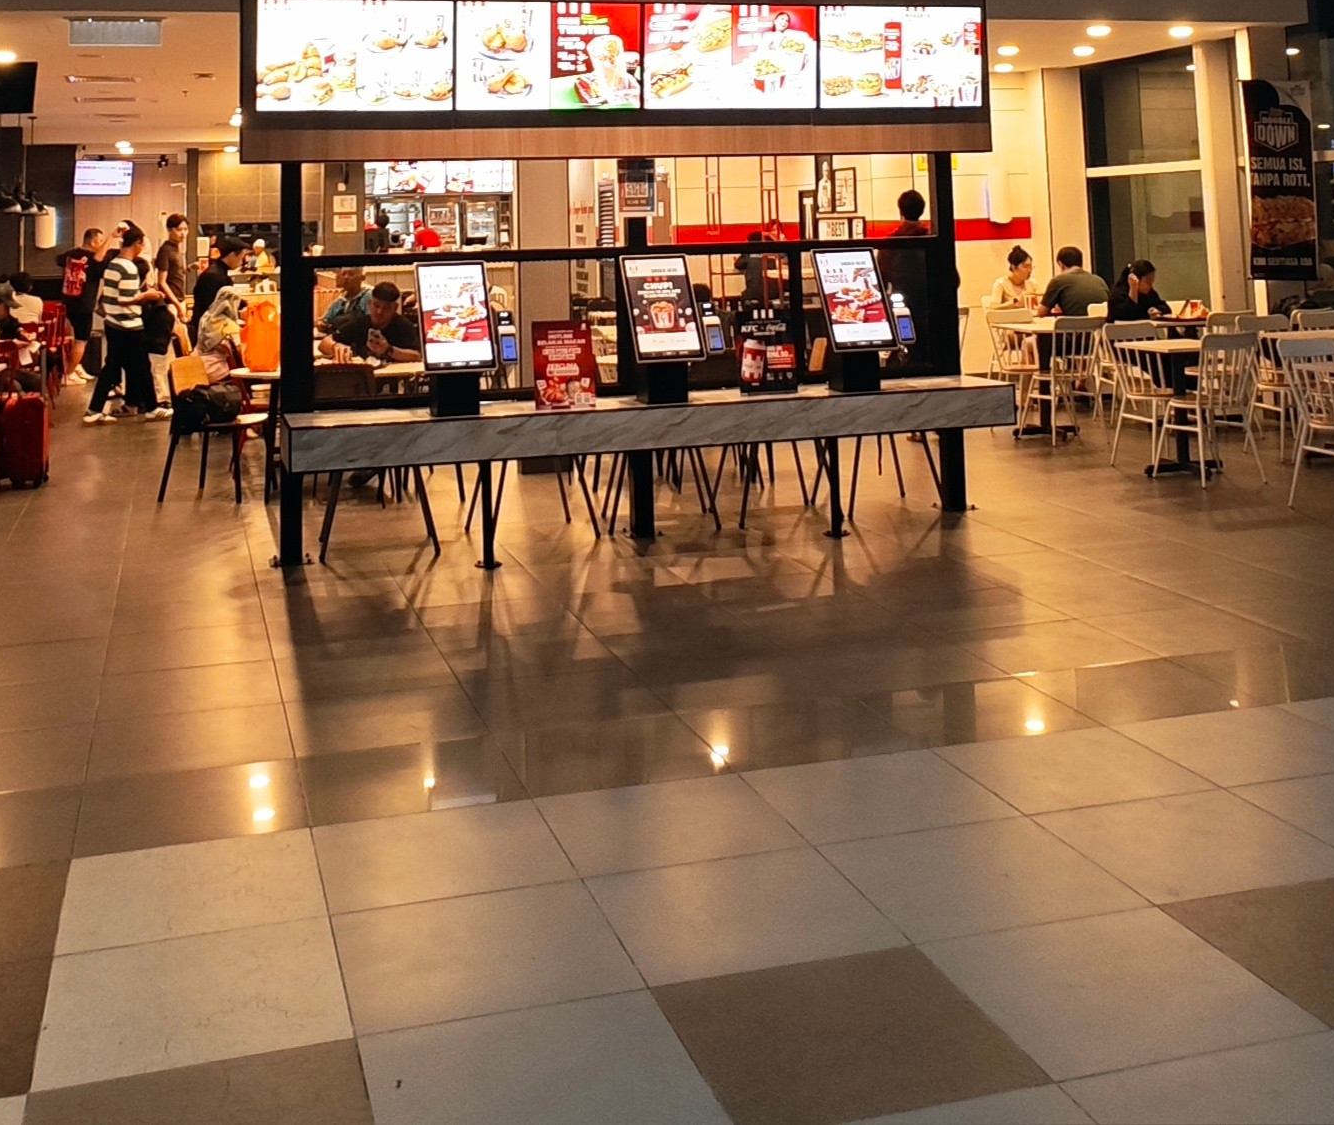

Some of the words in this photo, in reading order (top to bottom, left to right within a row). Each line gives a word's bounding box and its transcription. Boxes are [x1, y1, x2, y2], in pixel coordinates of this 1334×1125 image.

[1257, 124, 1295, 149] DOWN
[1251, 156, 1287, 170] SEMUA
[1283, 174, 1311, 187] ROTI.
